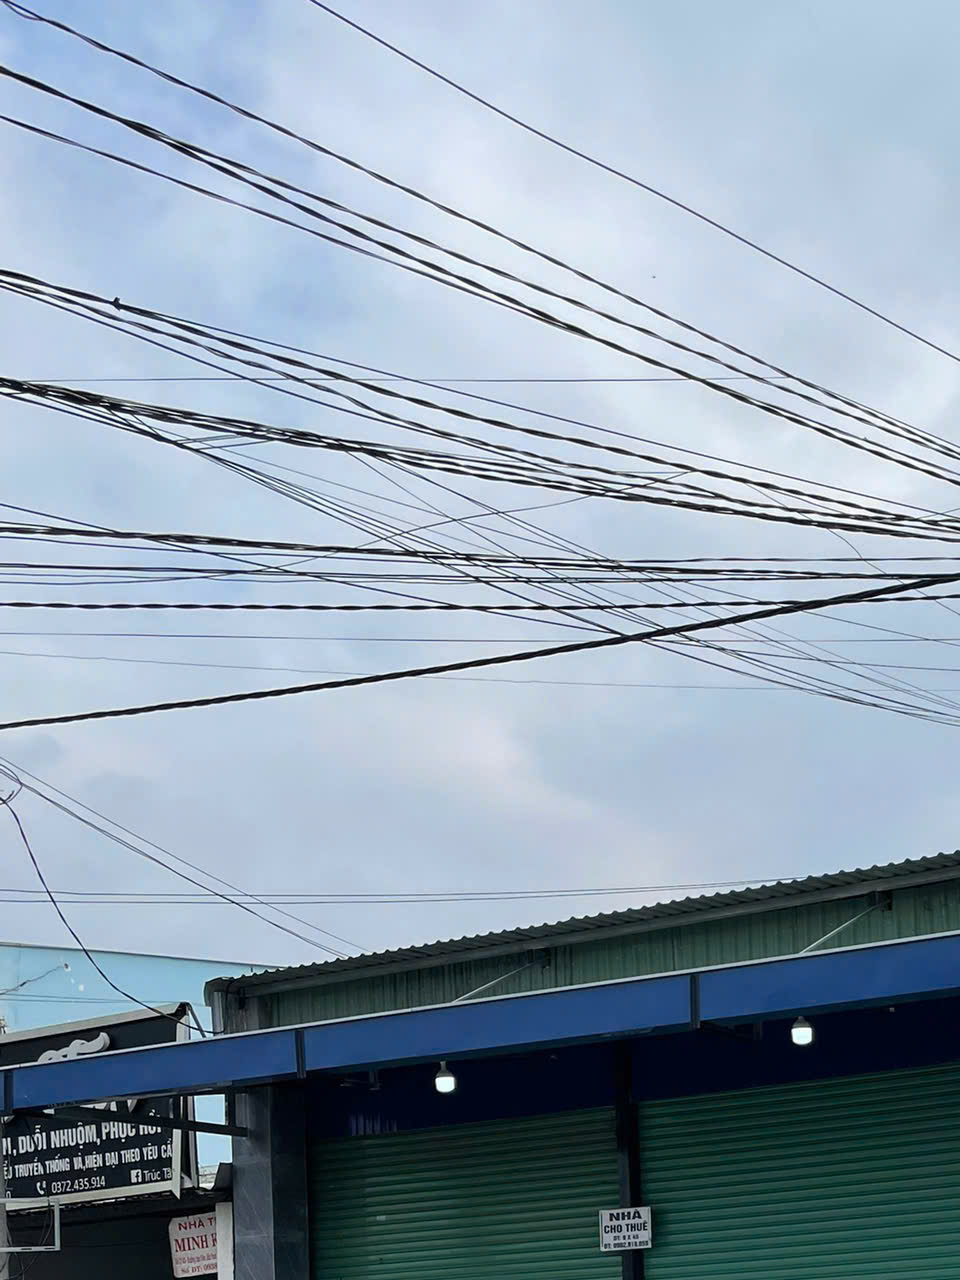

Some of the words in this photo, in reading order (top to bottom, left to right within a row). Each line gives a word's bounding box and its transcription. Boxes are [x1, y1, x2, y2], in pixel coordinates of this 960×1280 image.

[50, 1122, 100, 1149] NHUỘM,
[101, 1121, 136, 1143] PHỤC
[45, 1153, 70, 1174] THỐNG
[120, 1147, 141, 1164] THEO
[142, 1142, 158, 1161] YÊU
[161, 1137, 174, 1158] CẦ
[51, 1175, 106, 1194] 0372.435.914
[143, 1168, 161, 1183] Trúc
[609, 1208, 642, 1222] NHÀ
[603, 1224, 623, 1234] CHO
[625, 1220, 648, 1232] THUÊ
[174, 1234, 209, 1253] MINH
